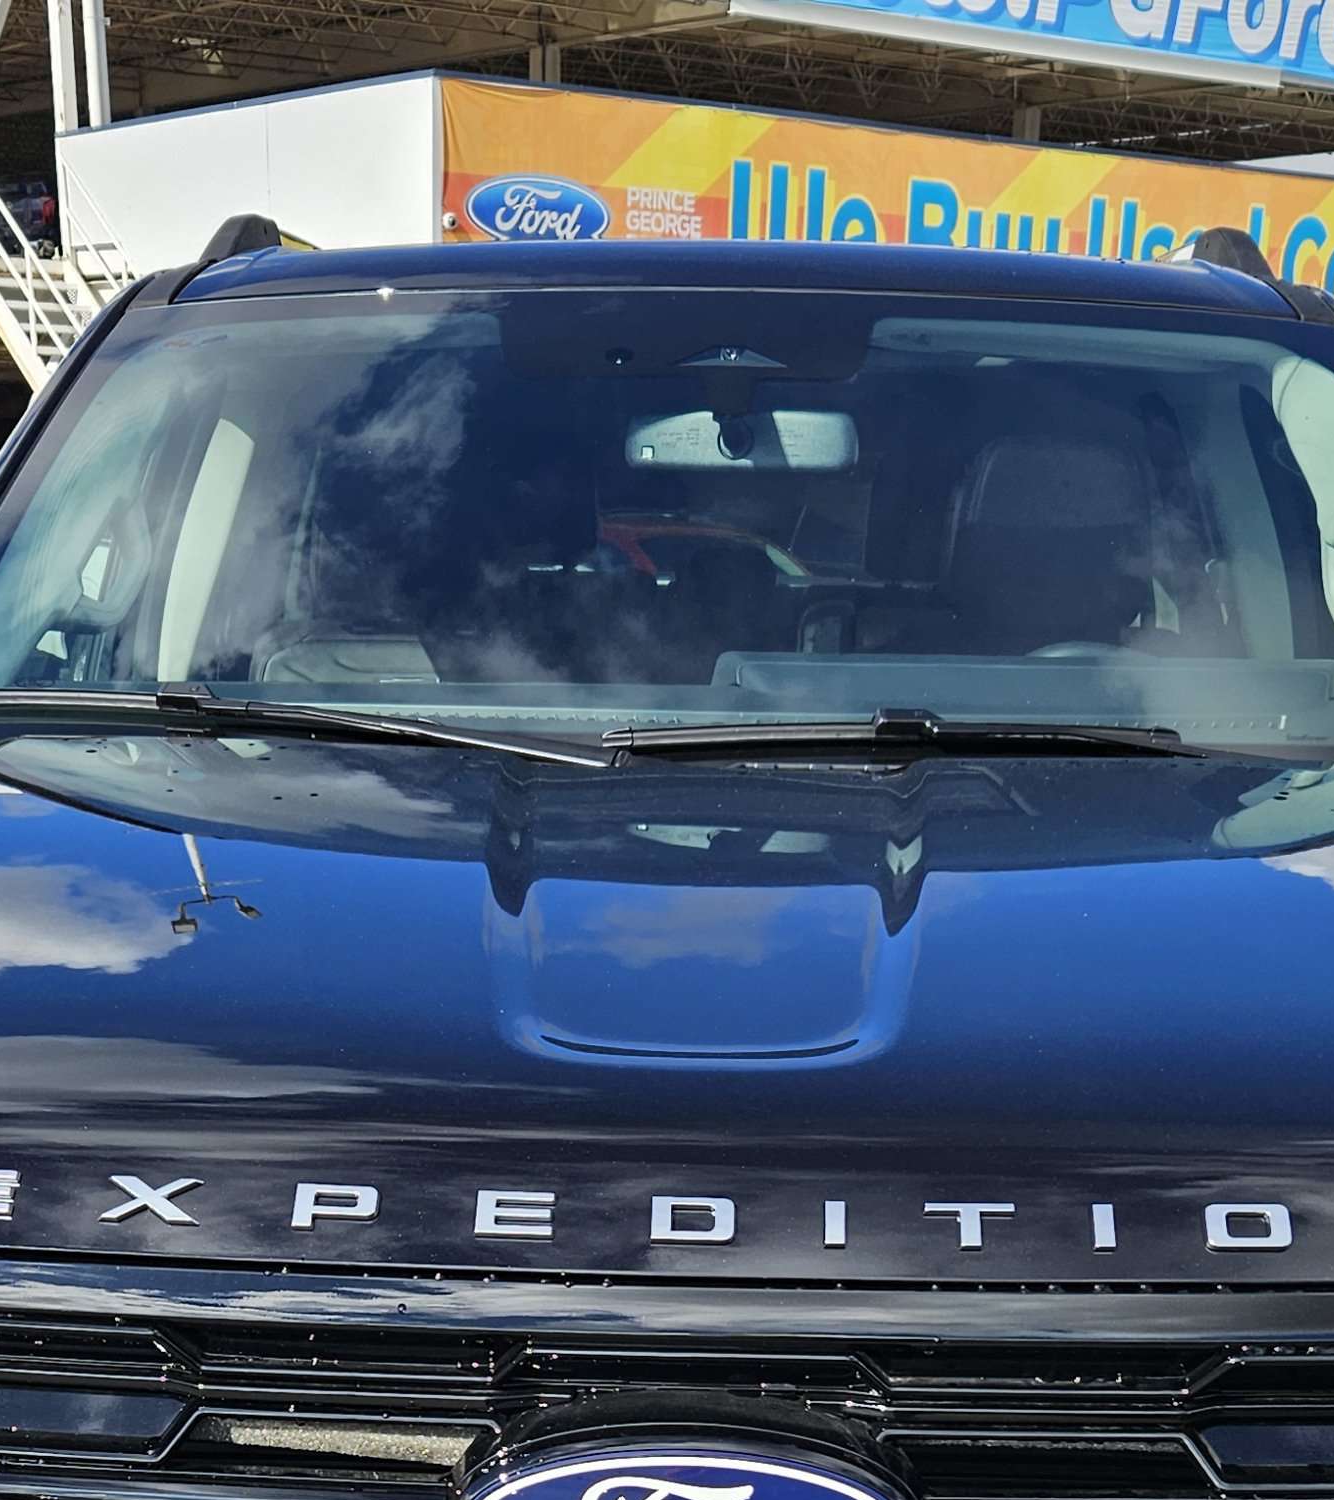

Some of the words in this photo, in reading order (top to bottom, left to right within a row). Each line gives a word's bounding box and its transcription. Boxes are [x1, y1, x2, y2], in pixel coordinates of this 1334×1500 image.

[495, 185, 584, 240] Ford
[627, 187, 696, 213] PRINCE
[627, 210, 703, 239] GEORGE
